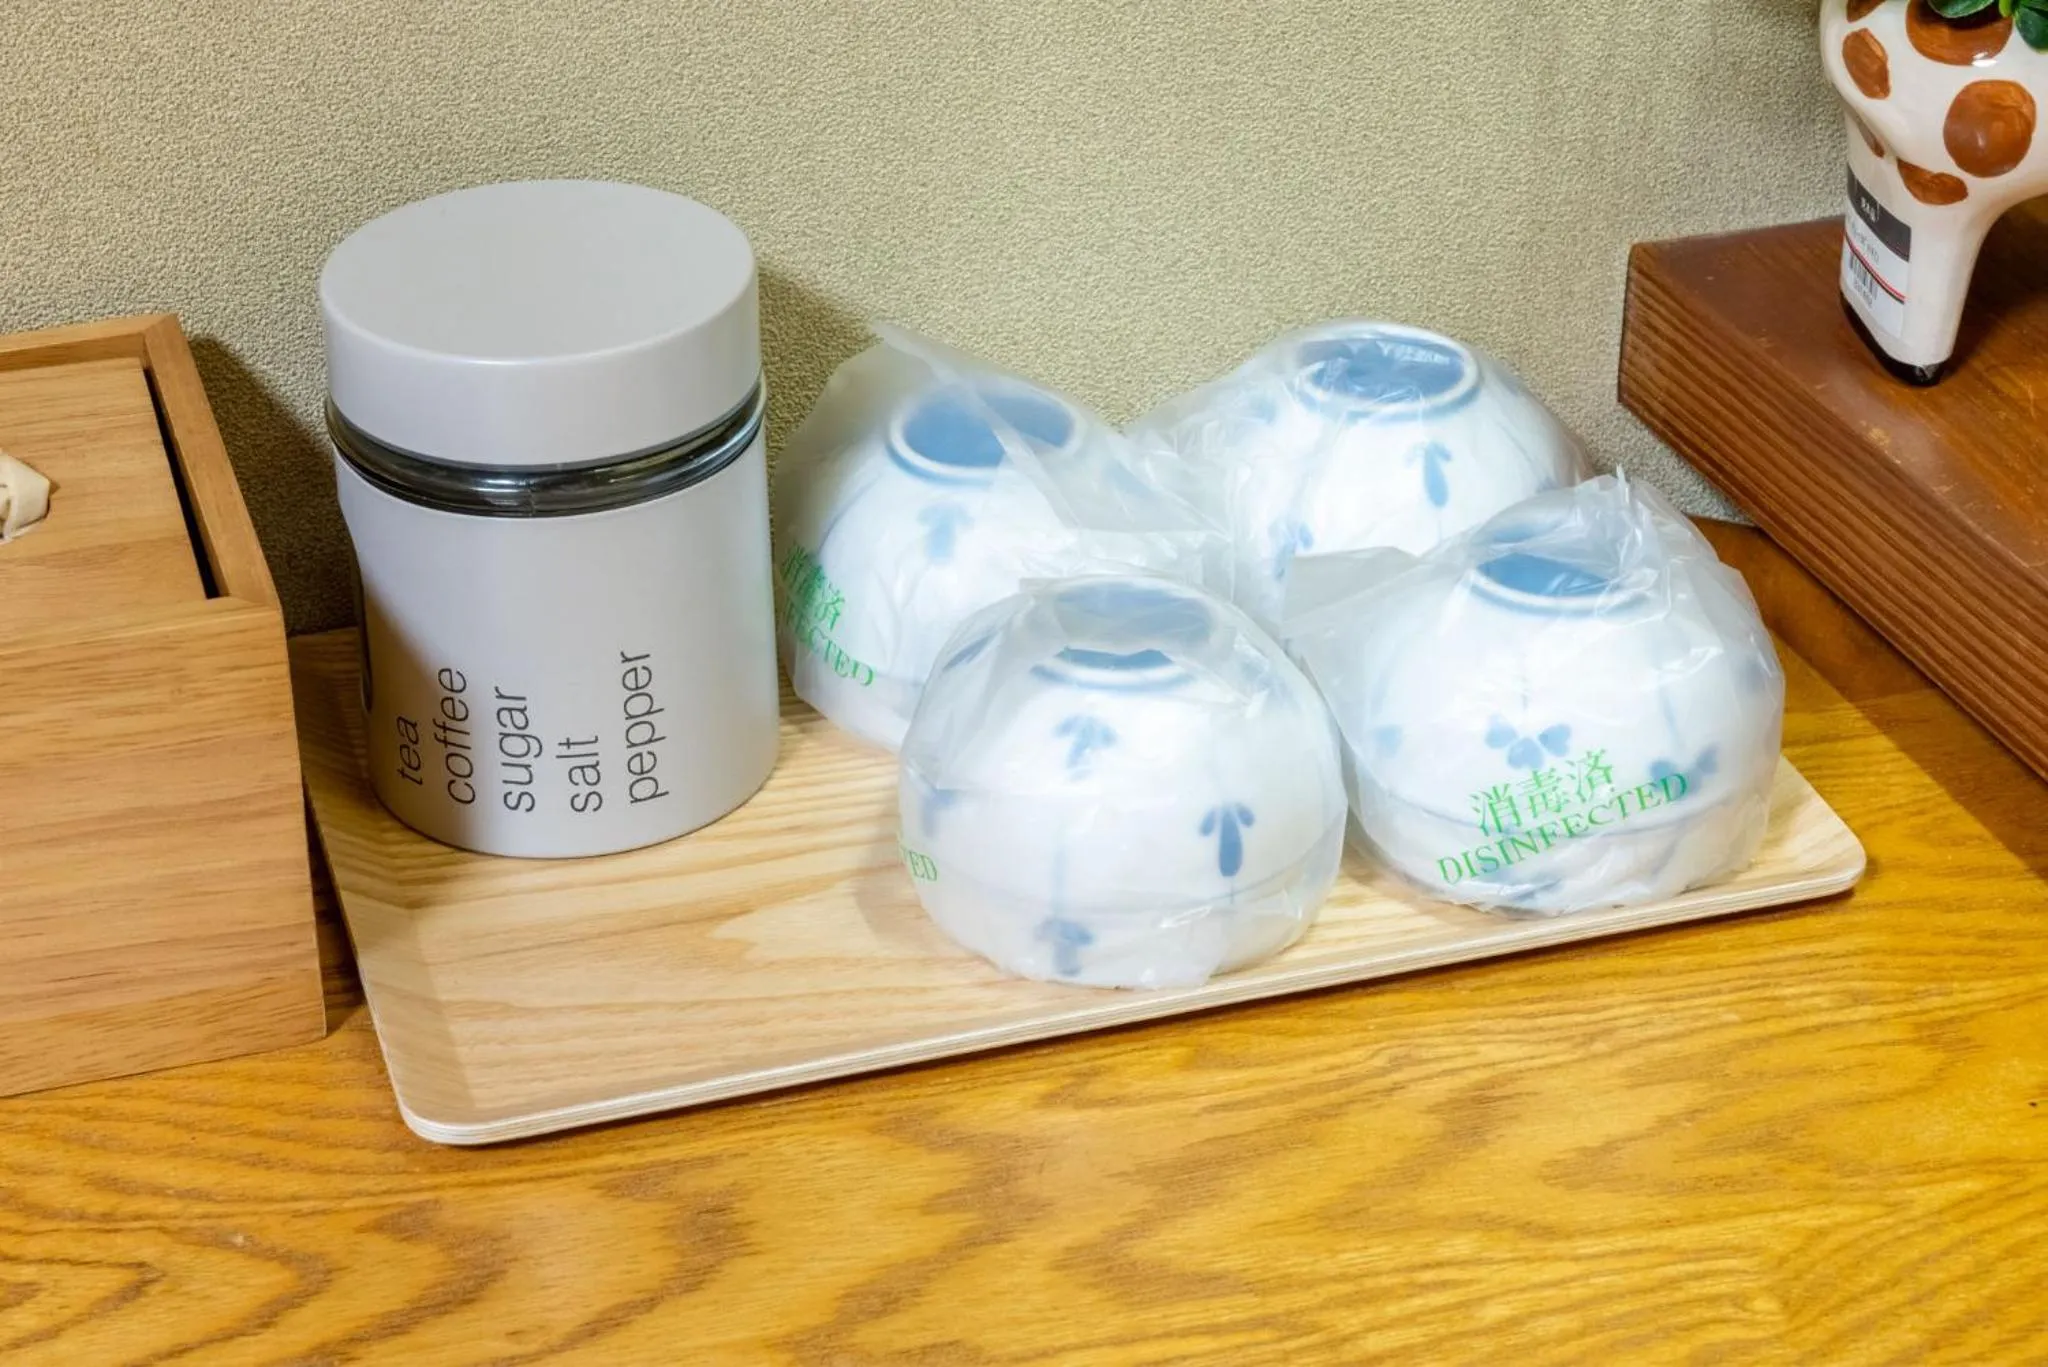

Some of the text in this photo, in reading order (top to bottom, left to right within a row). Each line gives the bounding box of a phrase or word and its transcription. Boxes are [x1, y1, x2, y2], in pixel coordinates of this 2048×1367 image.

[397, 716, 423, 785] tea
[433, 668, 476, 804] coffee
[495, 686, 543, 812] sugar
[556, 735, 603, 812] salt
[620, 651, 670, 804] pepper
[1437, 773, 1689, 885] DISINFECTED
[1469, 749, 1615, 836] 消毒済
